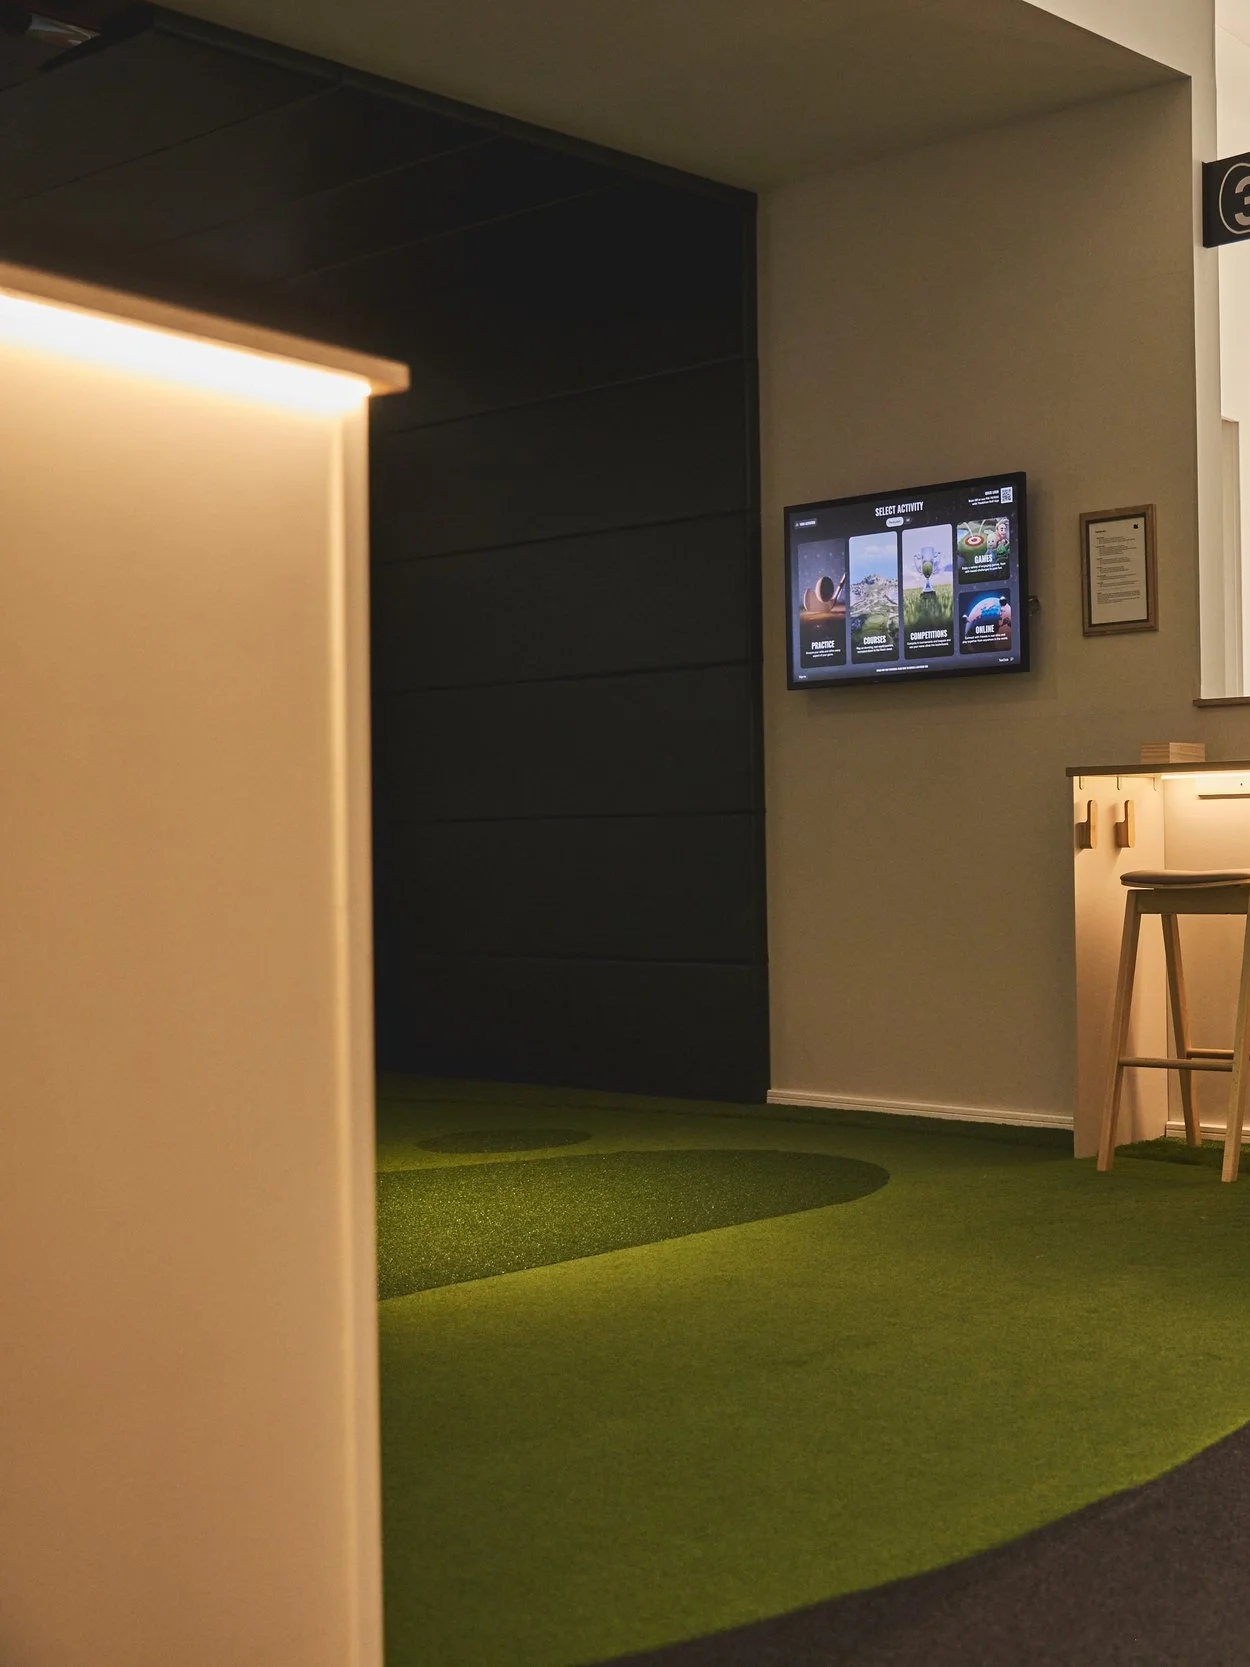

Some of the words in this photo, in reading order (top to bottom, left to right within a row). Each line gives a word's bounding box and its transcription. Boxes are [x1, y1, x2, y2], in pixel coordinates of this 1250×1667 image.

[875, 505, 896, 517] SELECT
[897, 501, 924, 514] ACTIVITY
[974, 554, 993, 564] GAMES
[975, 624, 995, 634] ONLINE
[910, 629, 948, 640] COMPETITIONS
[811, 640, 835, 650] PRACTICE
[863, 635, 887, 645] COURSES
